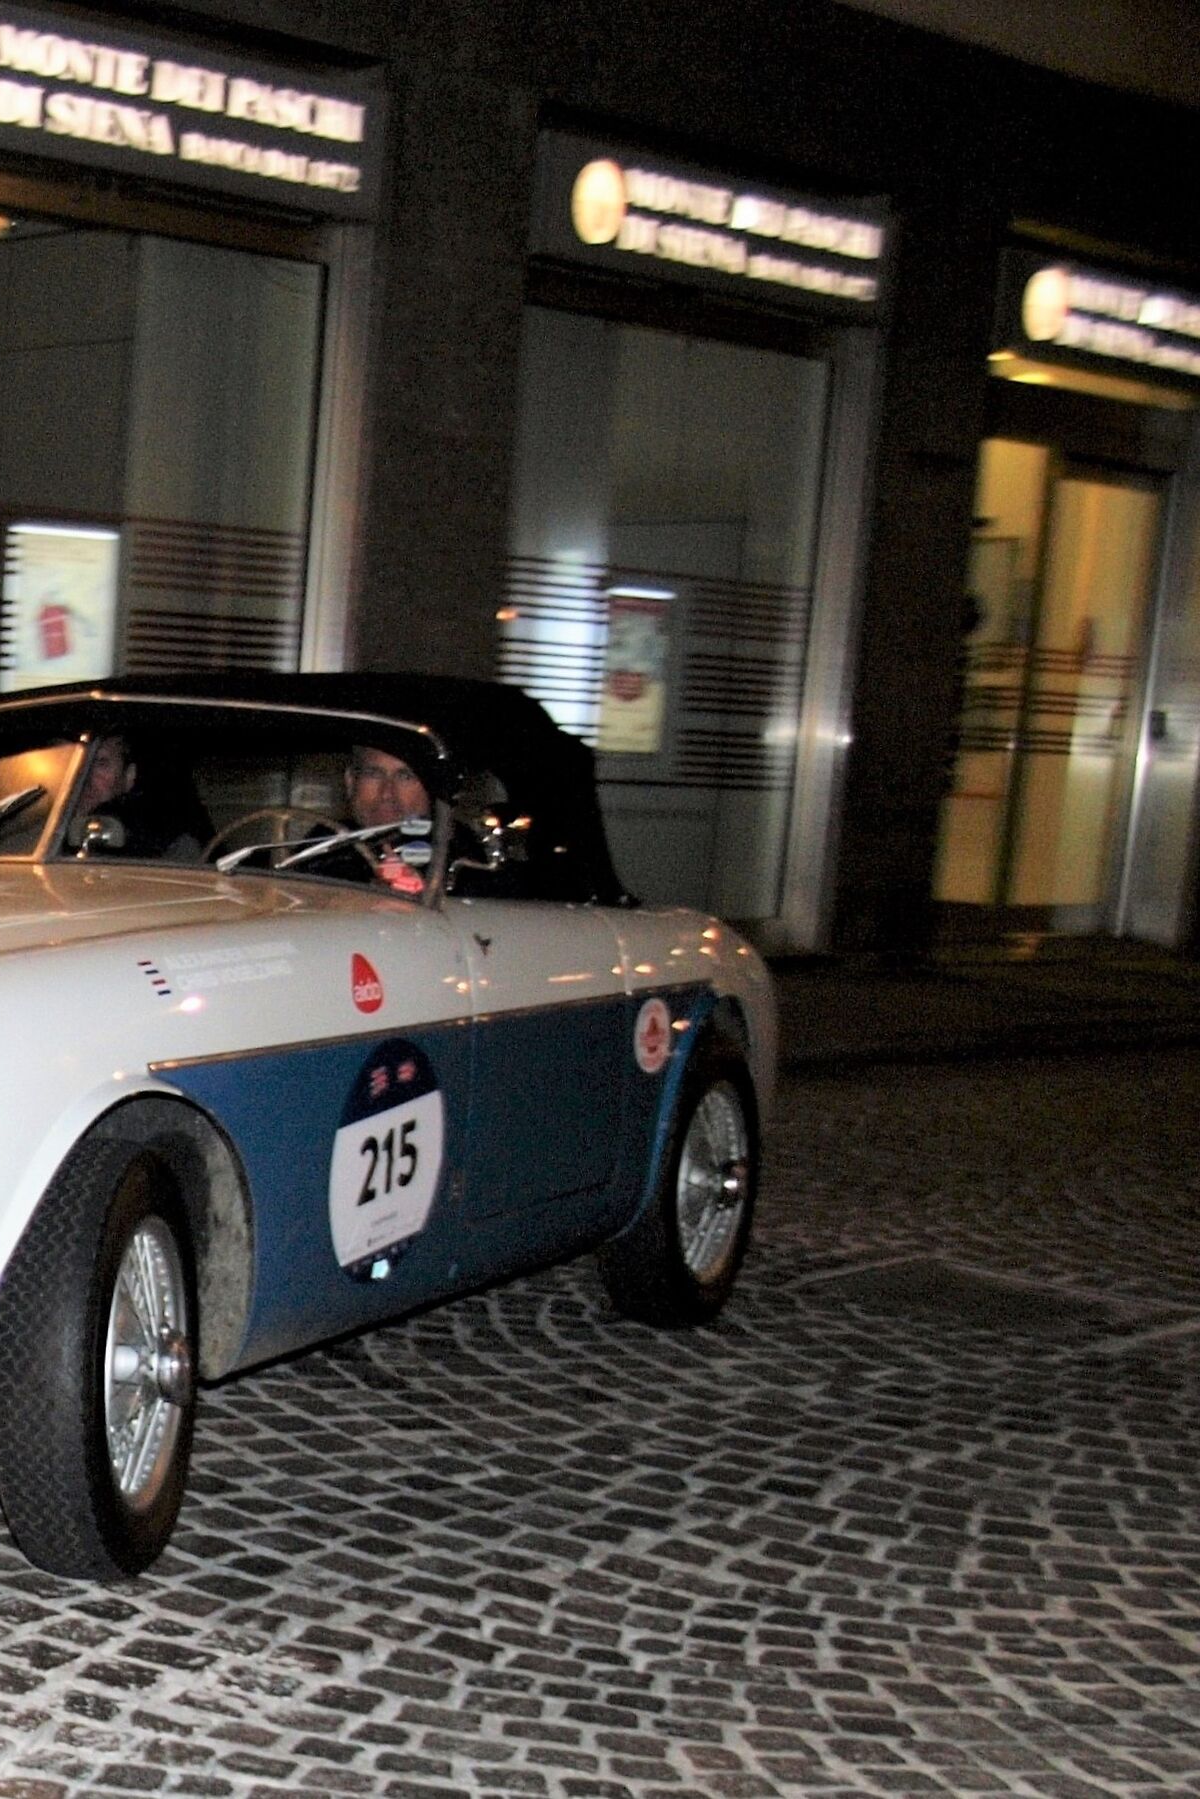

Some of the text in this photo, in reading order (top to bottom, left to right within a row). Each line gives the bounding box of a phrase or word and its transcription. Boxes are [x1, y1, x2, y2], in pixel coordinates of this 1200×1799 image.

[151, 61, 227, 111] DEI
[45, 92, 174, 154] SIENA
[357, 1118, 417, 1206] 215
